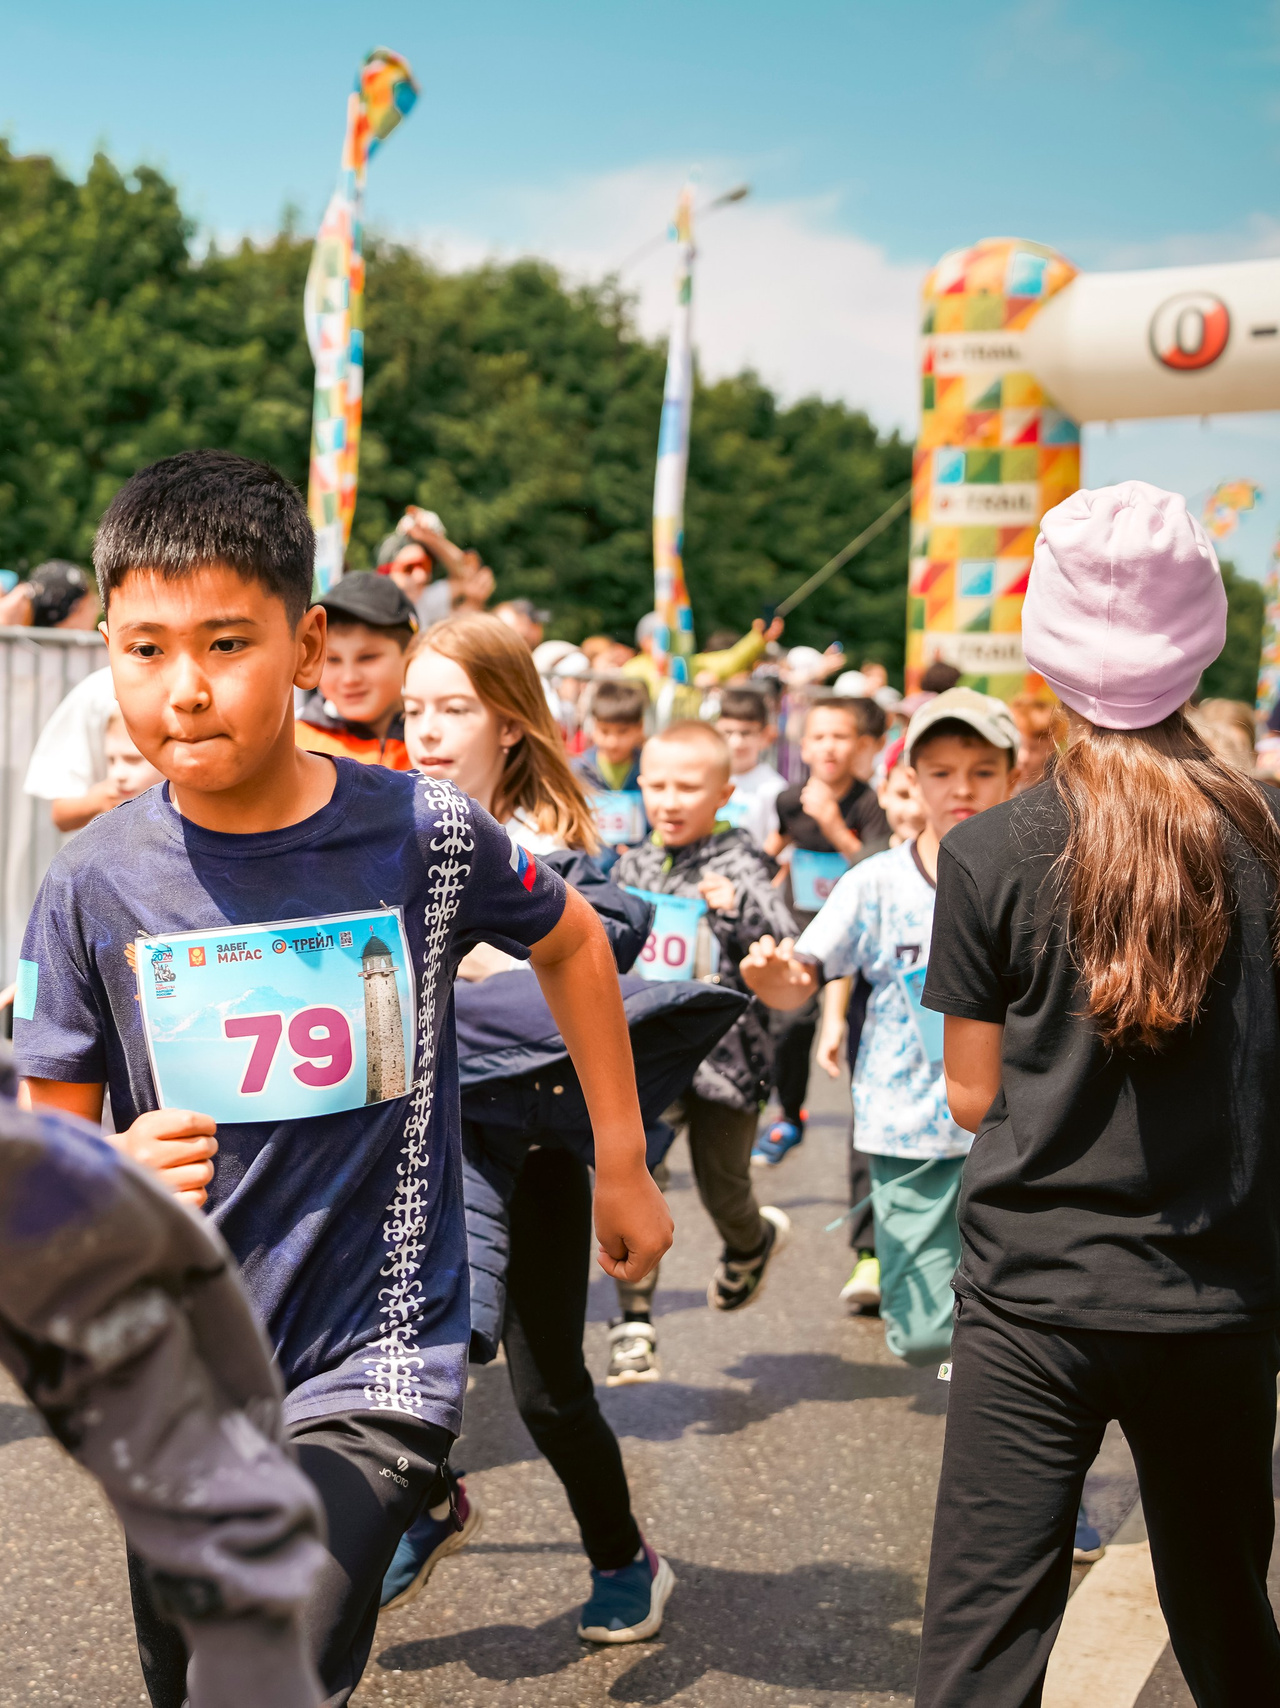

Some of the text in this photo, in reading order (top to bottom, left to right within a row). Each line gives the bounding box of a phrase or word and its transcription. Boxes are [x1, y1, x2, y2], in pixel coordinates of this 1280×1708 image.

[216, 942, 248, 953] ЗАБЕГ
[152, 952, 173, 962] 2026
[217, 949, 263, 964] МАГАС
[224, 1006, 353, 1094] 79
